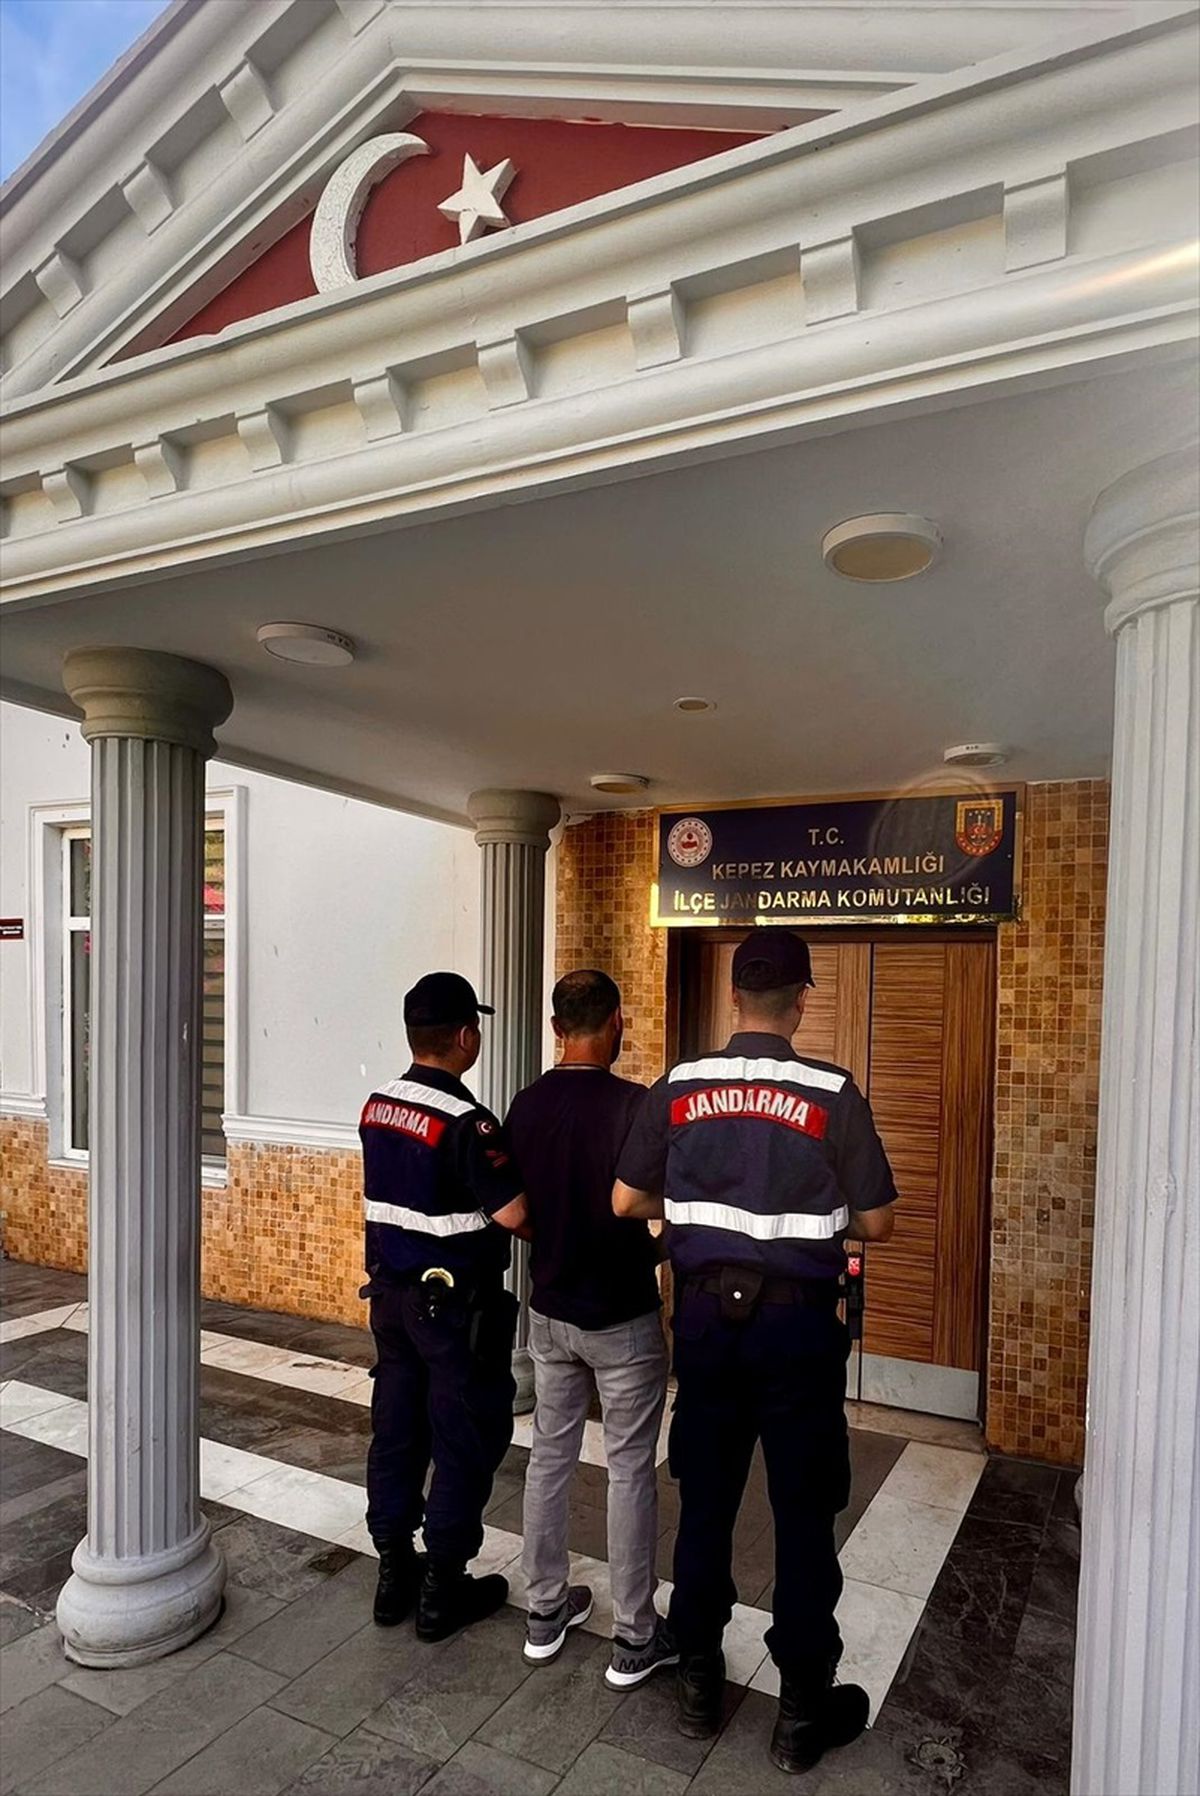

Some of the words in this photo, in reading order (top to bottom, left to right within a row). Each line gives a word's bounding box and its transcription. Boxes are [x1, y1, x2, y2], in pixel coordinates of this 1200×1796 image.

[807, 827, 845, 847] T.C.
[712, 861, 775, 881] KEPEZ
[780, 851, 944, 879] KAYMAKAMLIĞI
[673, 889, 716, 914] İLÇE
[720, 889, 832, 910] JANDARMA
[836, 882, 990, 908] KOMUTANLIĞI
[365, 1101, 431, 1138] JANDARMA
[685, 1088, 810, 1127] JANDARMA
